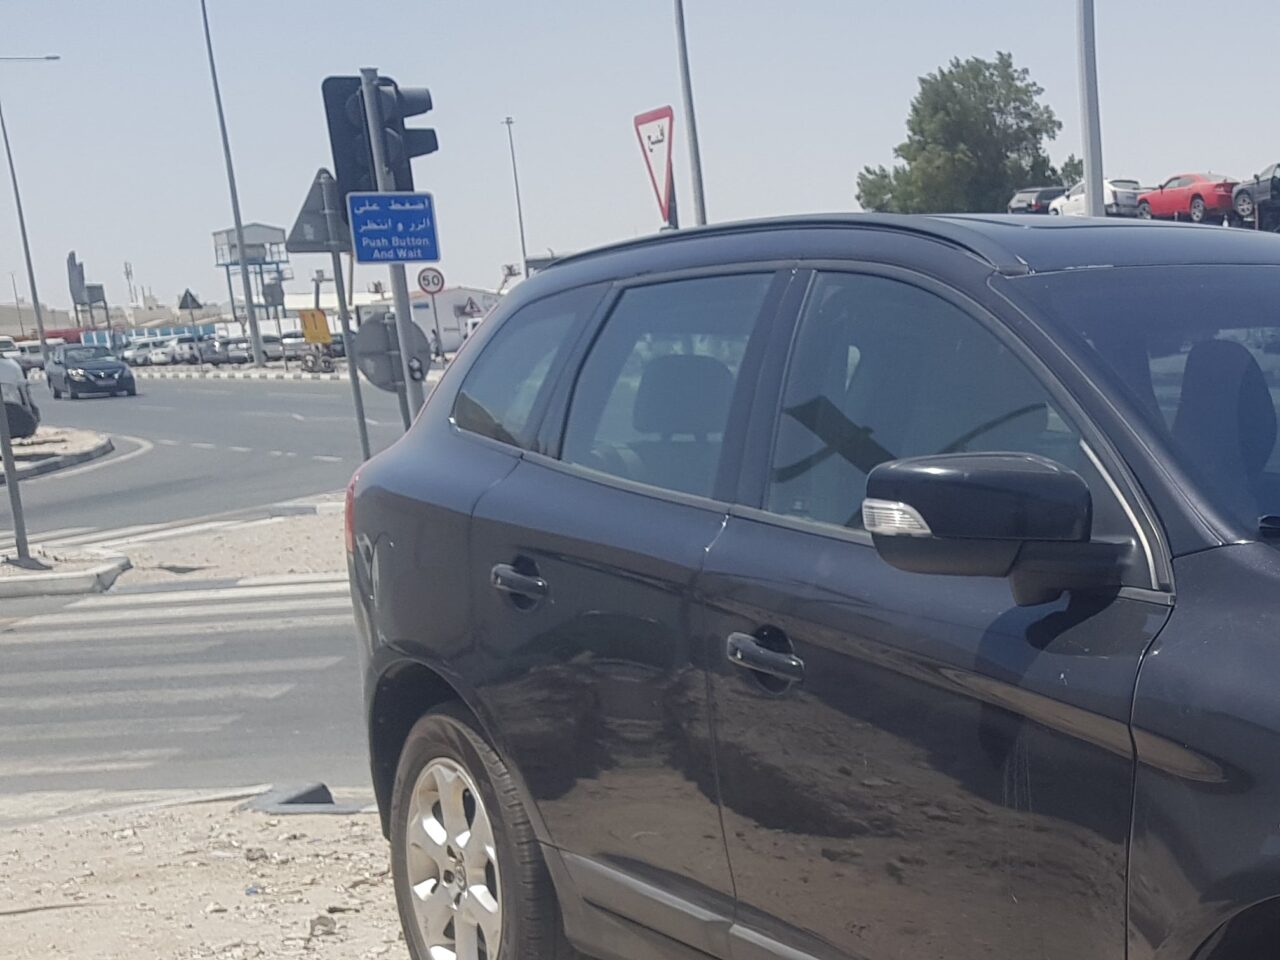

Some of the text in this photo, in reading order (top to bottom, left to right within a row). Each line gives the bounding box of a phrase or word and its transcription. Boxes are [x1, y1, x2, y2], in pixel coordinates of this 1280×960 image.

[362, 236, 430, 248] Push Button
[373, 247, 423, 259] And Wait
[422, 274, 441, 287] 50
